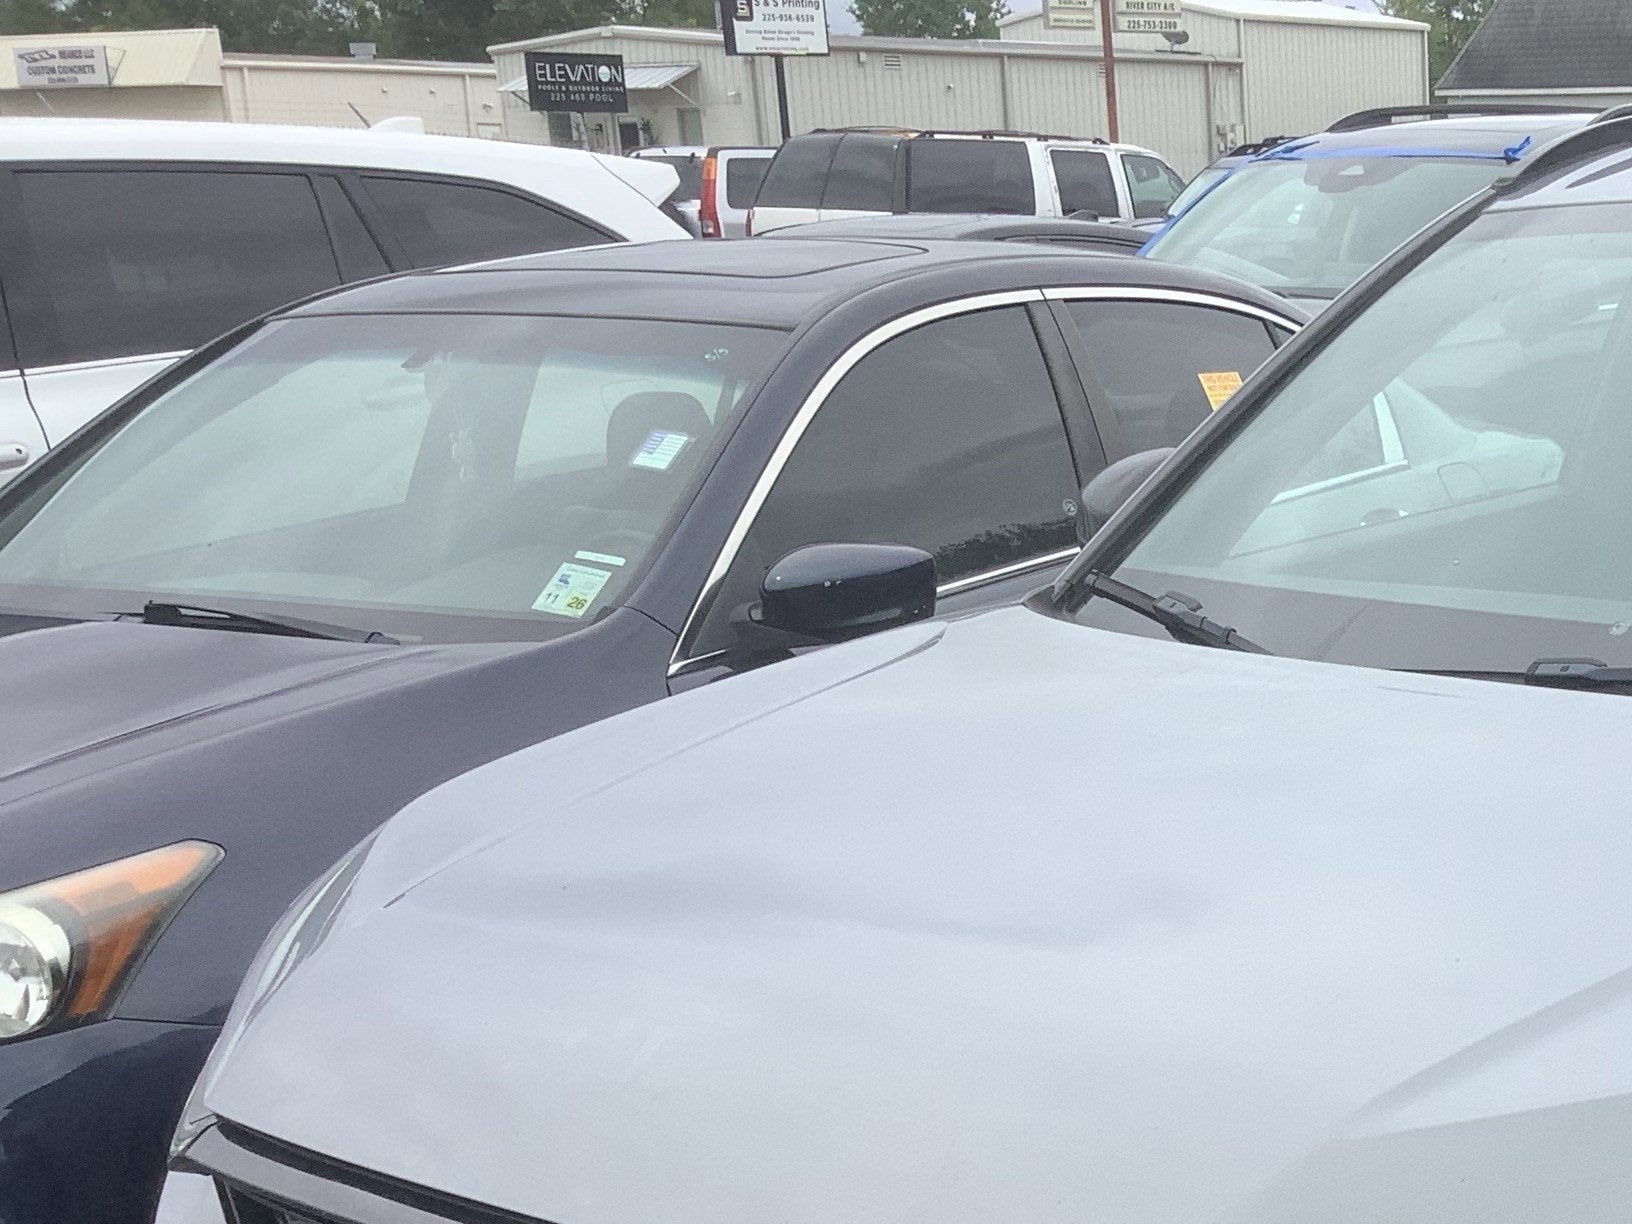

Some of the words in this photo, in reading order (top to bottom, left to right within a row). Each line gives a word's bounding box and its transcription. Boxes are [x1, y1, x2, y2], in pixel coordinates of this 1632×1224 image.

[782, 0, 820, 10] Printing
[1126, 1, 1144, 10] RIVER
[1147, 2, 1161, 10] CITY
[1127, 19, 1178, 30] 225-753-3300
[57, 64, 96, 75] CONCRETE
[535, 62, 623, 83] ELEVATION
[544, 592, 560, 605] 11
[567, 596, 588, 611] 26
